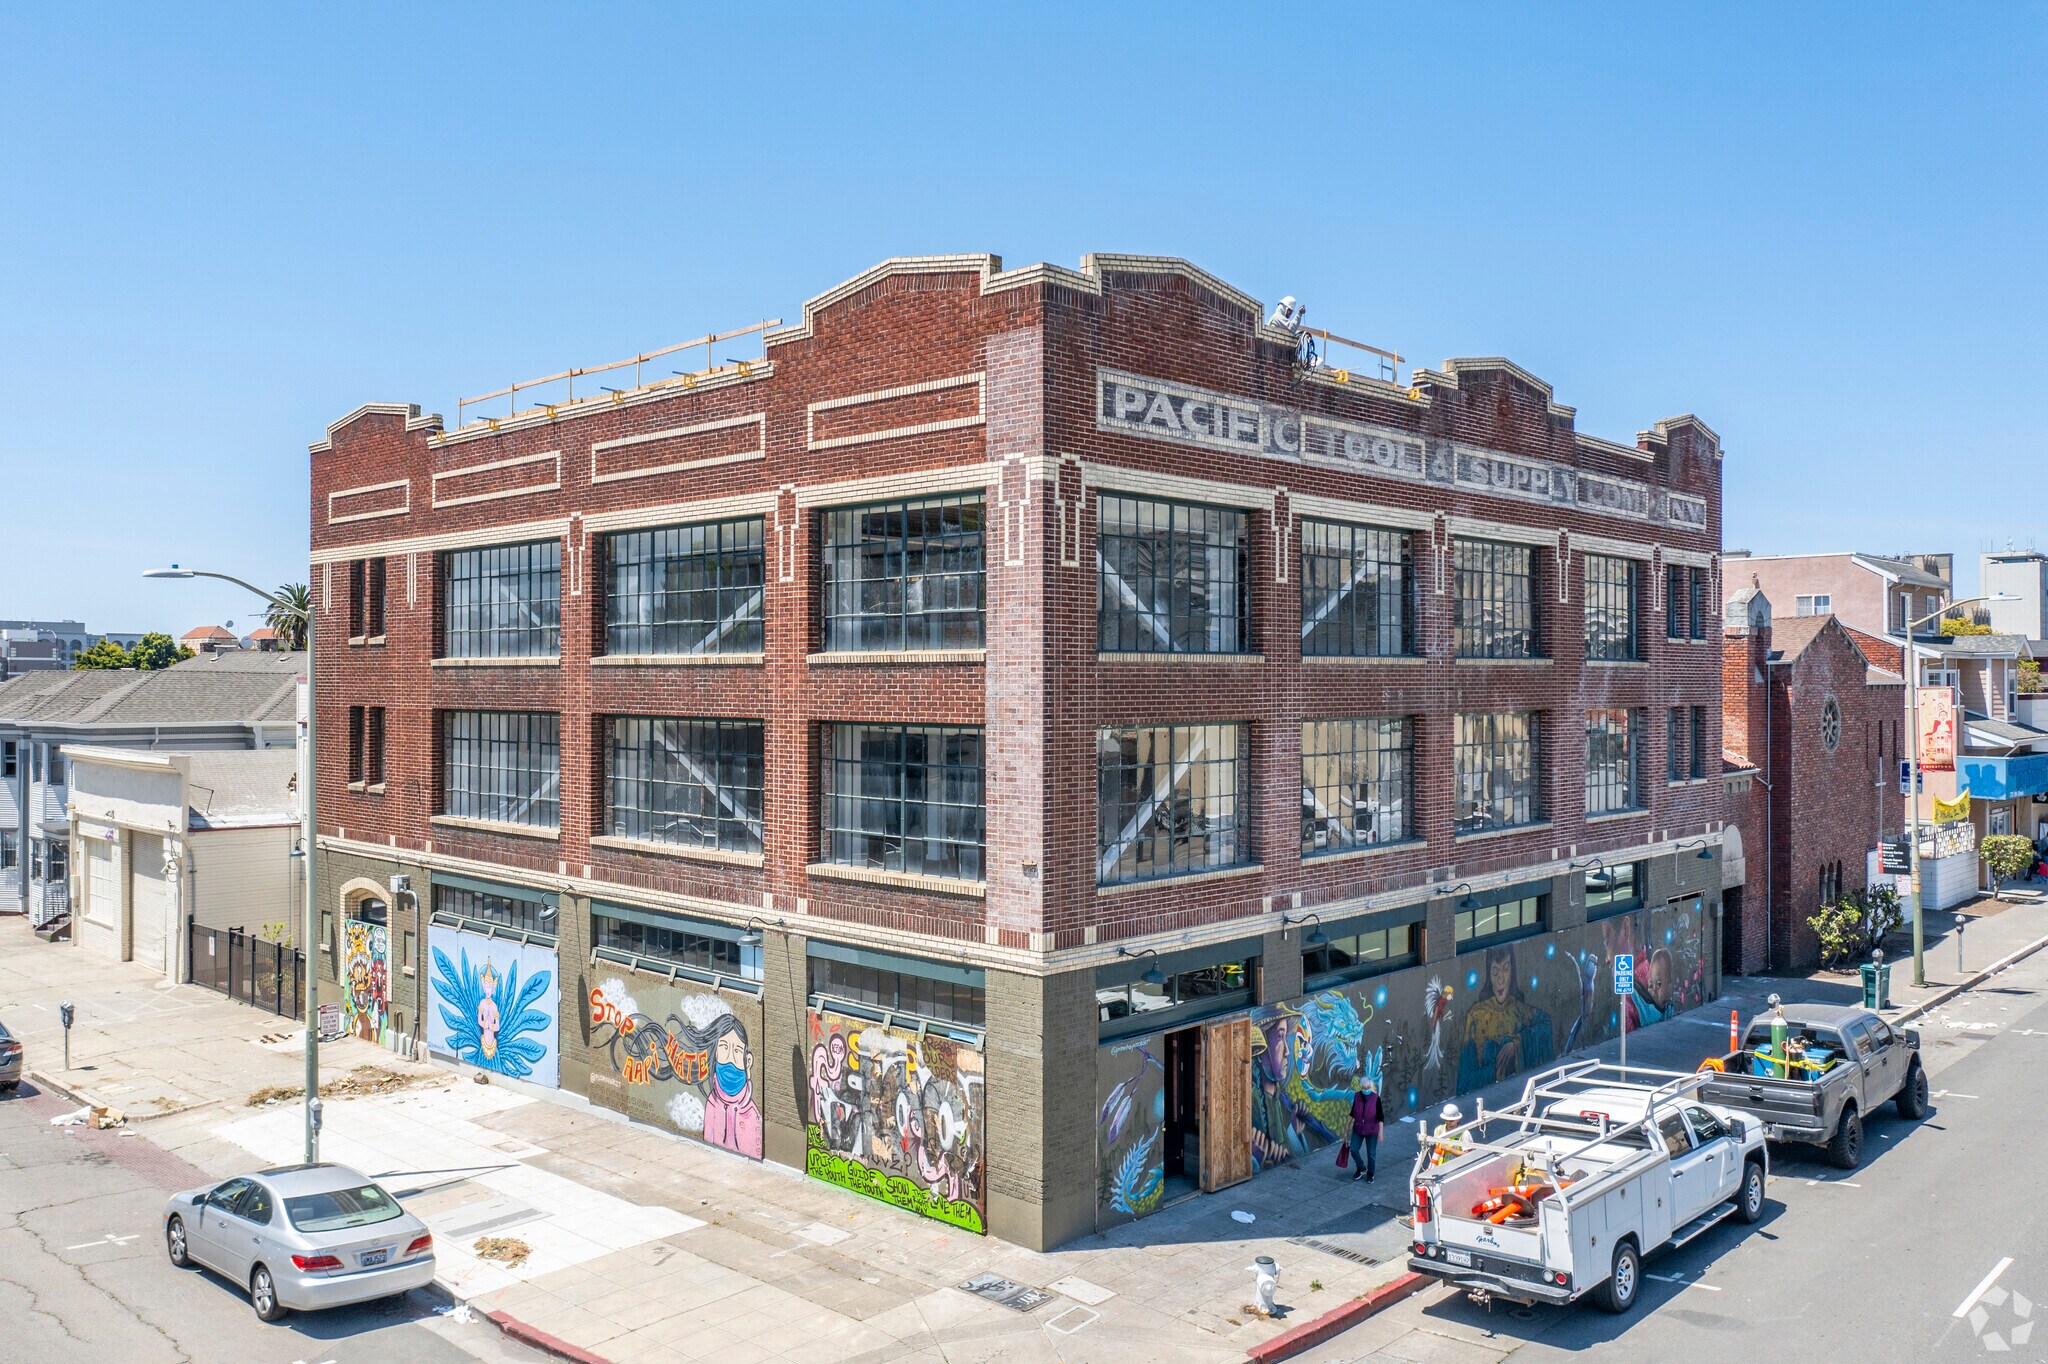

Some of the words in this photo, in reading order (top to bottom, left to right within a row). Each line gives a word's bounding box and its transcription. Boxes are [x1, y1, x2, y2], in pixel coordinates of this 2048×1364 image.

[1114, 384, 1300, 452] PACIFIC
[1318, 427, 1419, 472] TOOL
[1431, 446, 1450, 478] &
[1470, 458, 1575, 499] SUPPLY
[1586, 480, 1702, 523] COMPANY
[590, 987, 636, 1036] STOP
[666, 1028, 709, 1083] HATE
[810, 1153, 836, 1168] UPLIFT
[810, 1167, 823, 1176] THE
[825, 1168, 846, 1184] YOUTH
[848, 1162, 876, 1183] GUIDE
[848, 1177, 861, 1189] THE
[862, 1181, 884, 1198] YOUTH
[886, 1179, 910, 1195] SHOW
[892, 1195, 914, 1209] THEM
[930, 1197, 950, 1215] LOVE
